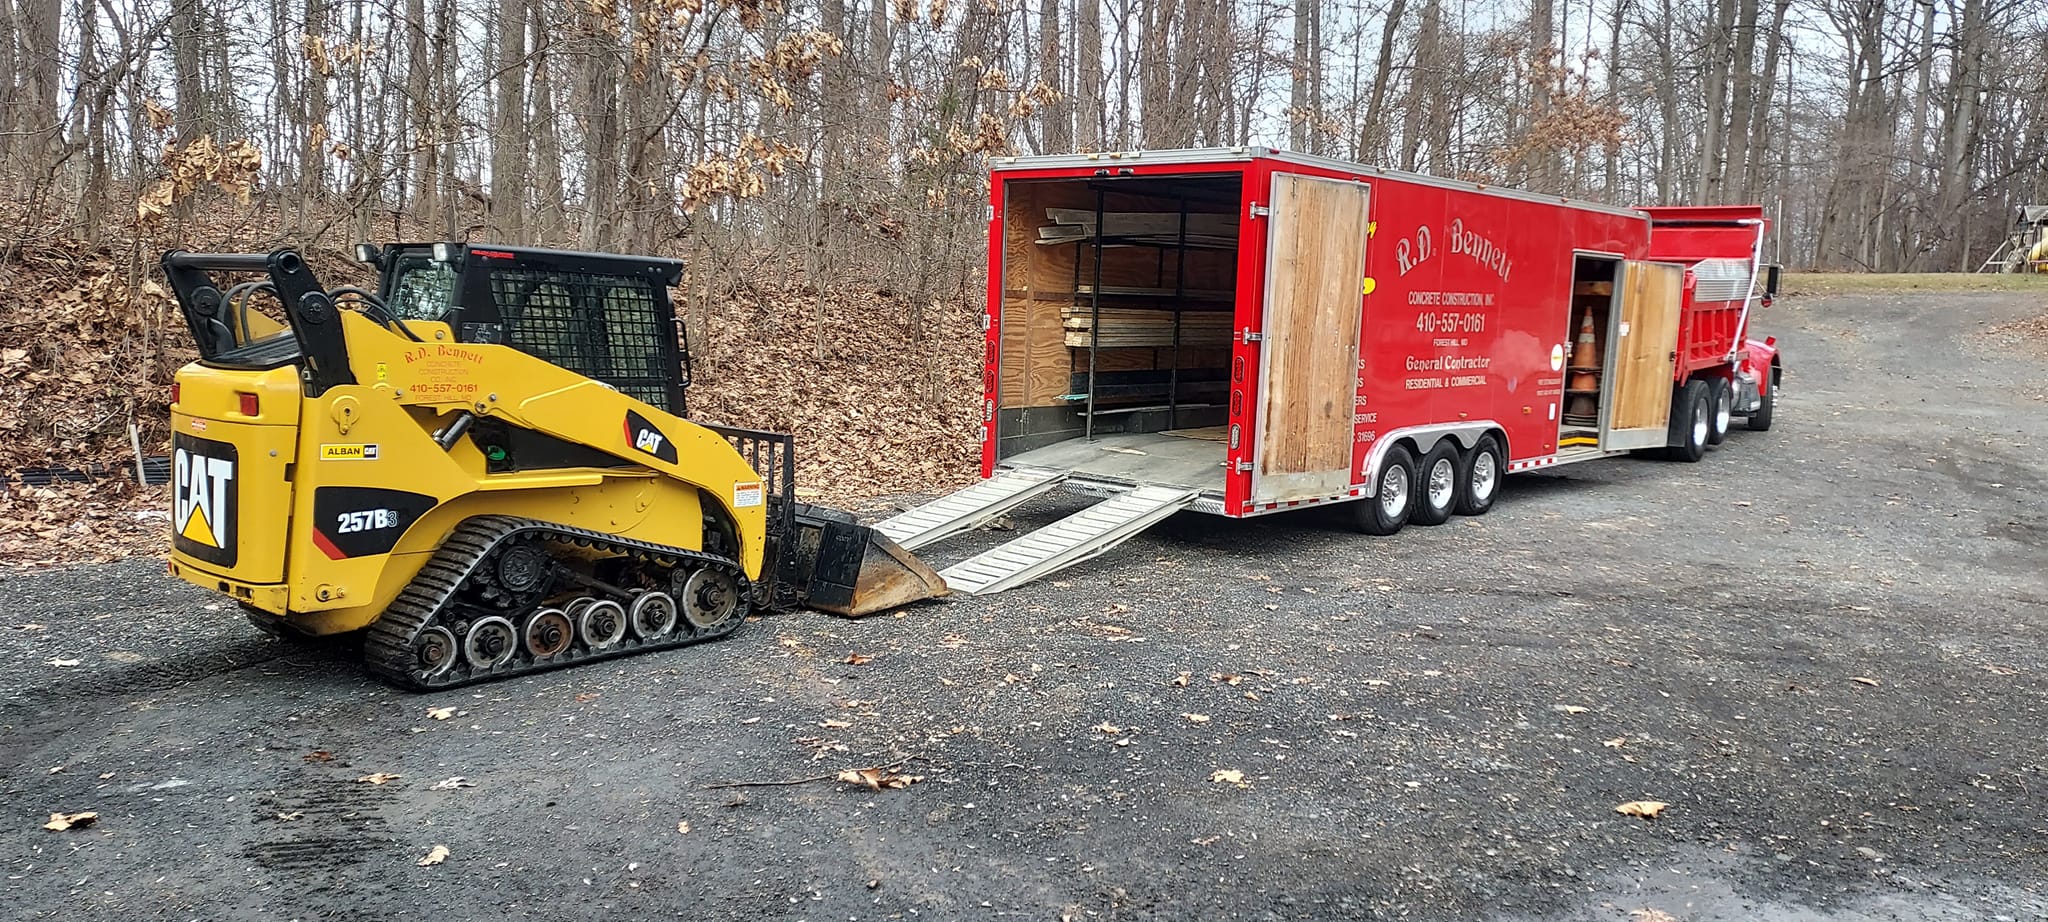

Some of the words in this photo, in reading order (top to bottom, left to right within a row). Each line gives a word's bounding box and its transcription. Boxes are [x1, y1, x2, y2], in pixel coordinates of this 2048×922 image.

[1451, 217, 1513, 283] Bennett
[1408, 291, 1441, 305] CONCRETE
[1416, 312, 1486, 333] 410-557-0161
[438, 344, 484, 364] Bennett
[1406, 355, 1443, 373] General
[1445, 355, 1491, 371] Contractor
[409, 384, 478, 393] 410-557-0161
[1405, 378, 1443, 390] RESIDENTIAL
[1451, 376, 1487, 387] COMMERCIAL
[637, 429, 663, 454] CAT
[175, 448, 233, 549] CAT
